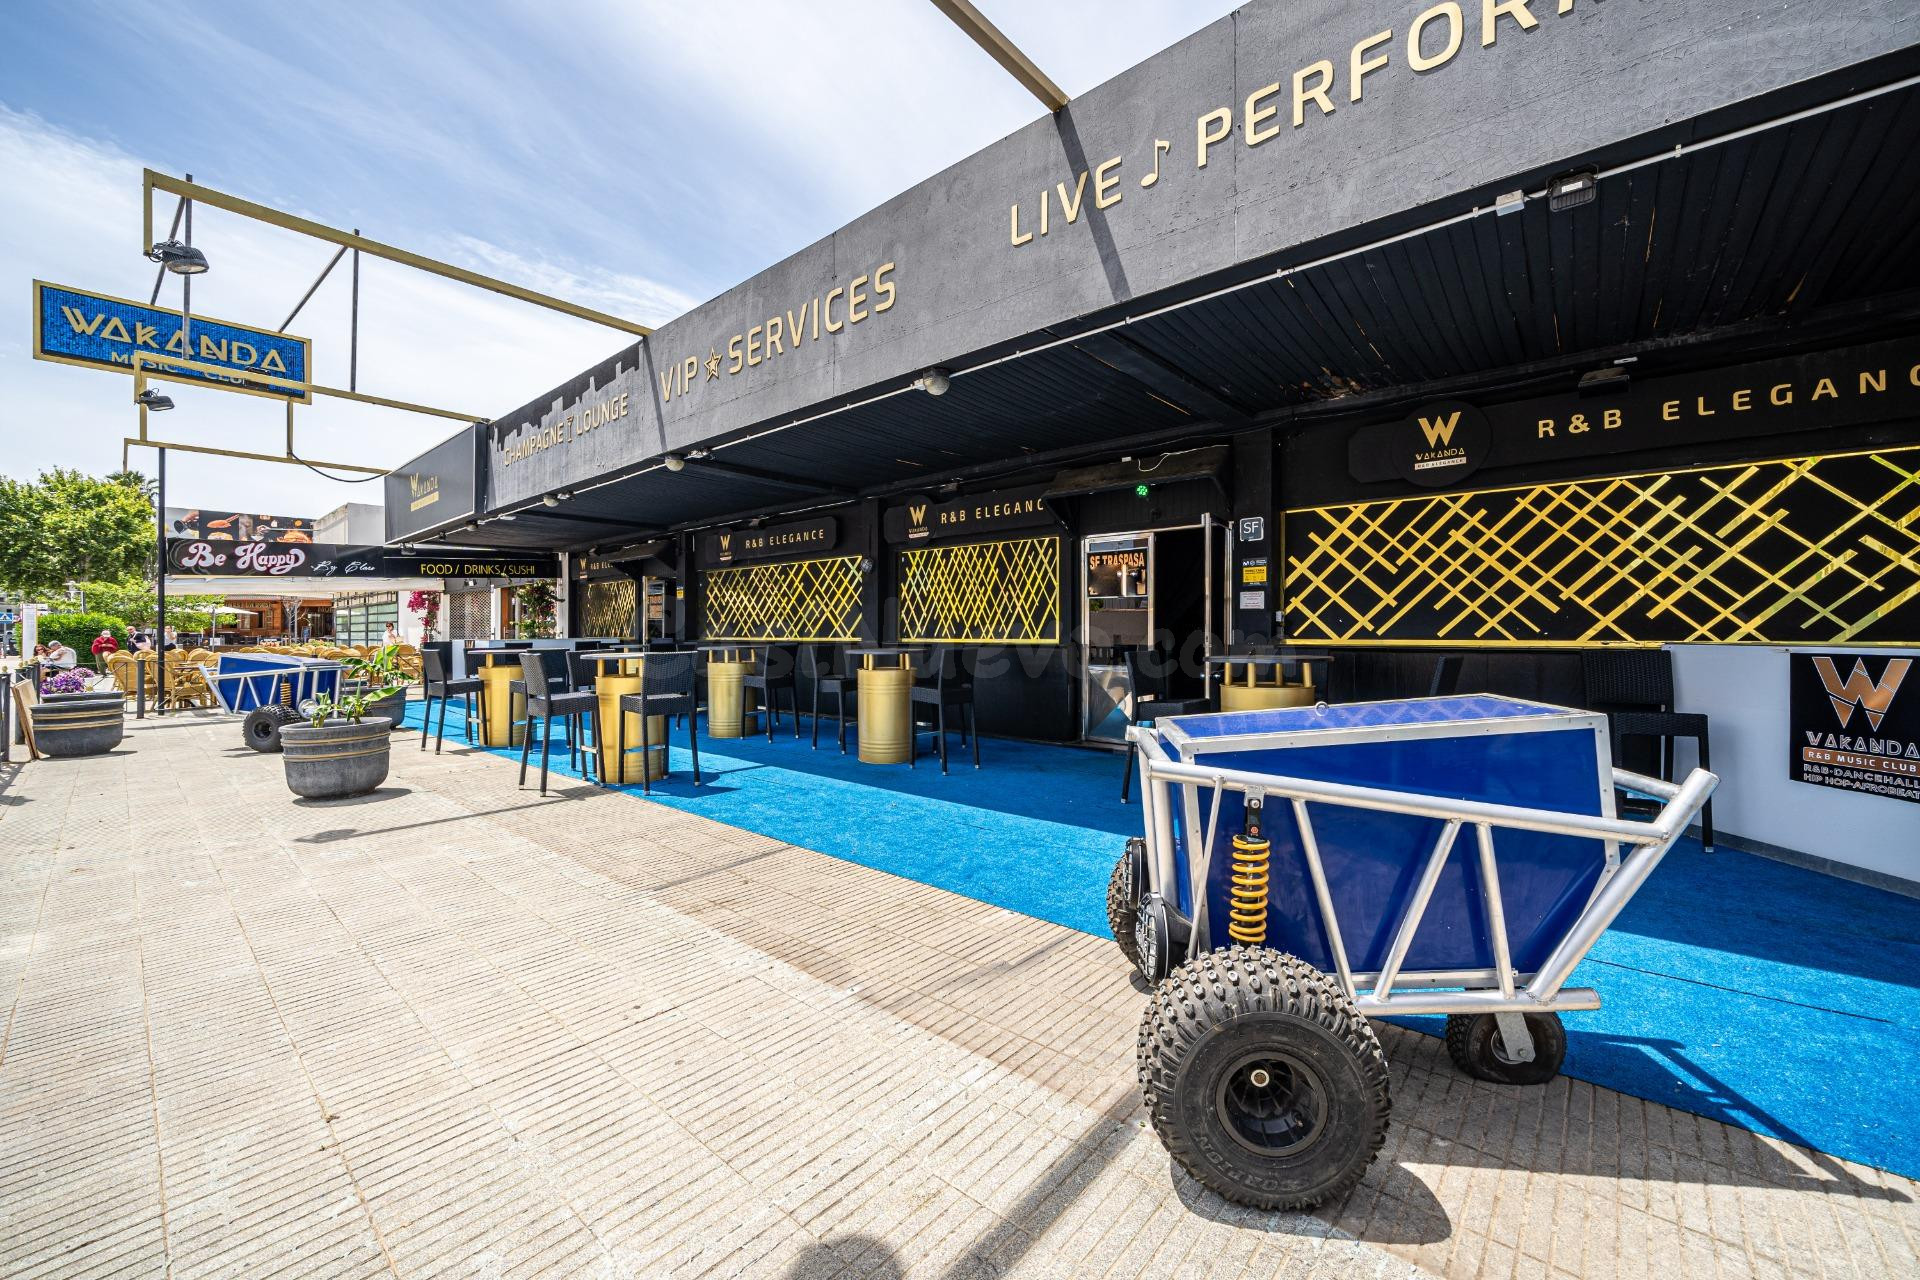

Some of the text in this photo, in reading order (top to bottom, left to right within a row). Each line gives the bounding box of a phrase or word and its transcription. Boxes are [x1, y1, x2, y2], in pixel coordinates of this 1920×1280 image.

[1011, 0, 1573, 246] LIVE PERFOR
[61, 306, 287, 372] WAKANDA
[660, 262, 896, 402] VIP SERVICES
[111, 352, 178, 373] MSIC
[504, 393, 628, 466] CHAMPAGNE LOUNGE
[1417, 411, 1461, 449] W
[1538, 409, 1622, 438] R&B
[941, 498, 1044, 524] R&B ELEGANC
[745, 529, 824, 549] R&B ELEGANCE
[1243, 522, 1259, 534] SF
[181, 542, 228, 567] Be
[234, 542, 306, 575] Happy
[420, 563, 452, 575] FOOD
[464, 565, 500, 574] DRINKS
[508, 565, 535, 575] SUSHI
[1102, 552, 1145, 567] TRASPASA
[1808, 751, 1917, 773] R&B MUSIC CLUB
[1803, 773, 1822, 783] HIP
